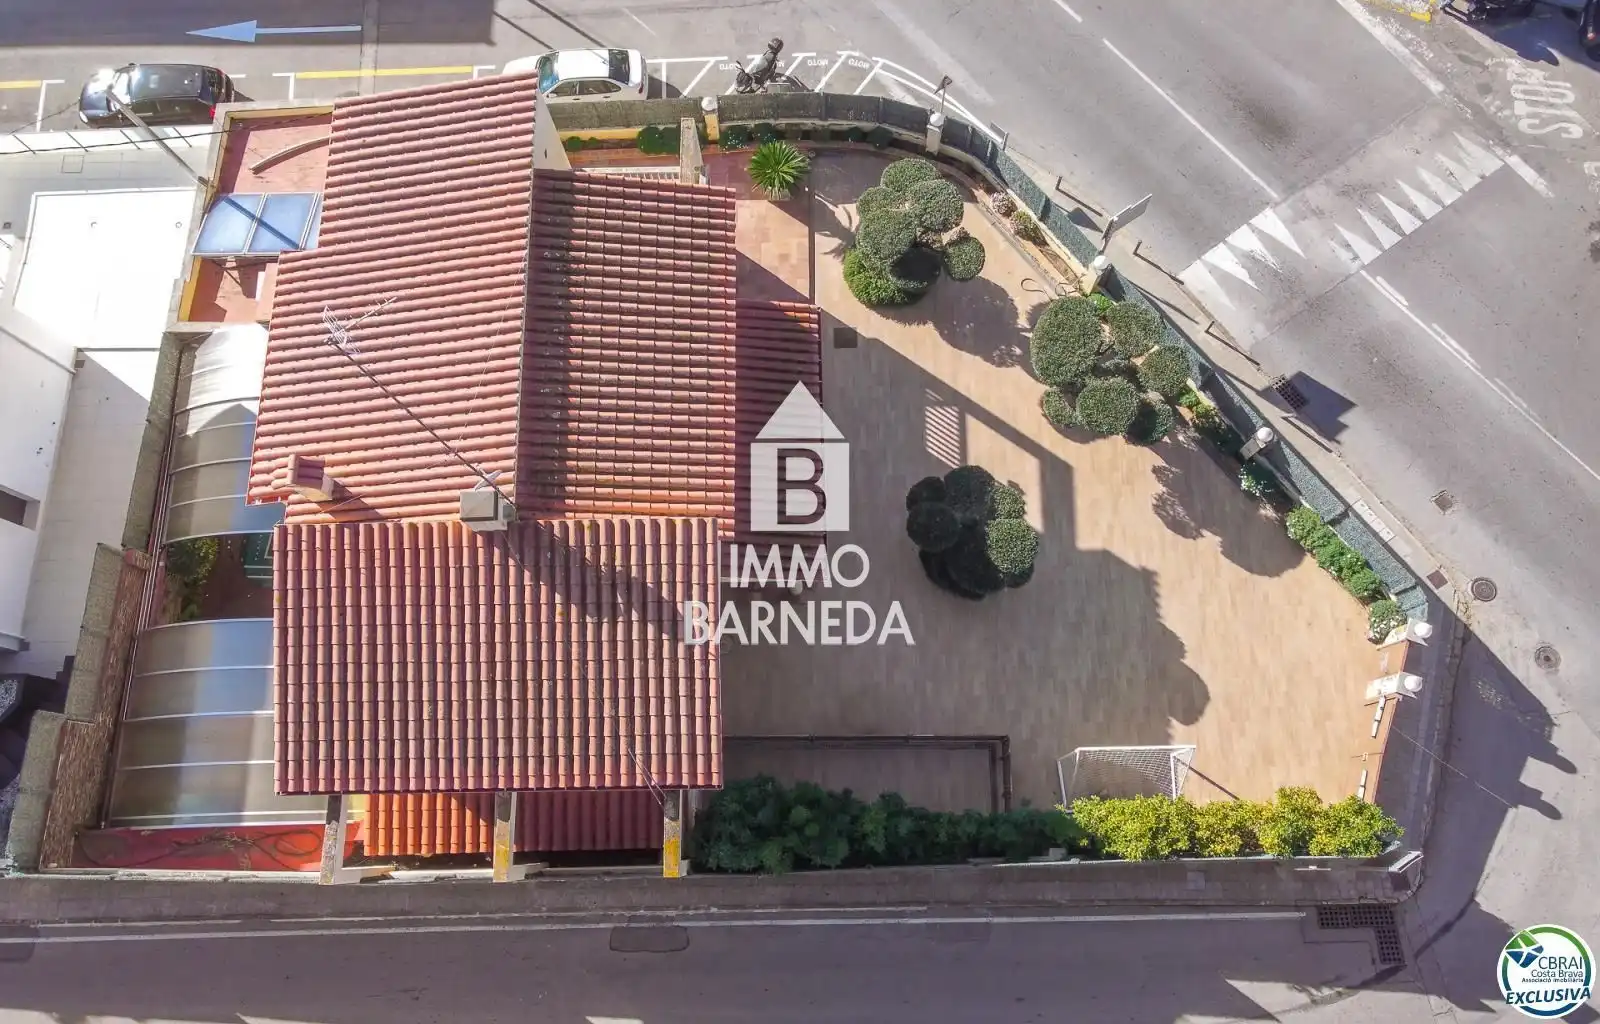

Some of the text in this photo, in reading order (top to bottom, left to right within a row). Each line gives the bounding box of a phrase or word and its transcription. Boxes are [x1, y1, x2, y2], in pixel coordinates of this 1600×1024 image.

[807, 59, 829, 67] MOTO
[848, 58, 871, 70] MOTO
[1507, 67, 1584, 139] STOP
